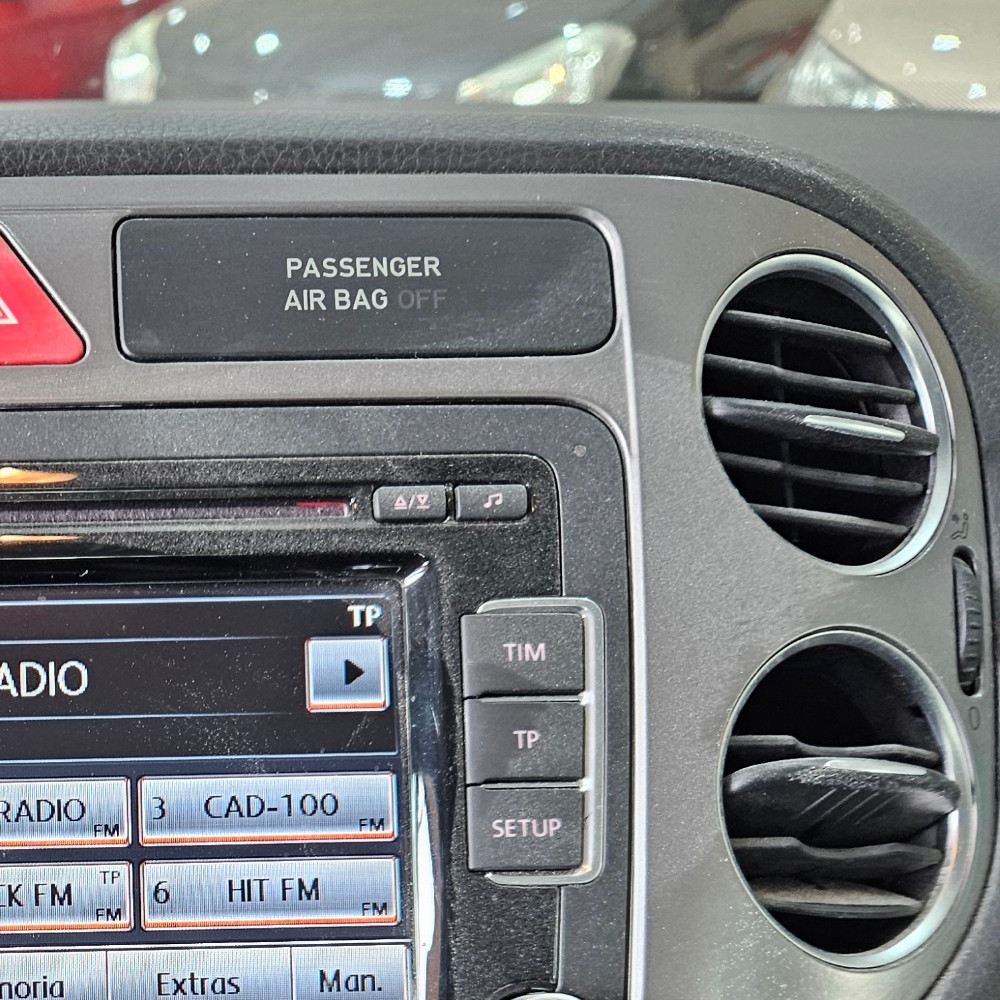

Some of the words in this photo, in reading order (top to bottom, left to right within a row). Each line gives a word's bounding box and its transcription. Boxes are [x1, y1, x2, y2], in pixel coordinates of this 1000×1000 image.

[286, 256, 441, 278] PASSENGER
[284, 289, 327, 311] AIR
[334, 288, 388, 310] BAG
[397, 288, 448, 310] OFF
[347, 604, 382, 627] TP
[503, 642, 546, 662] TIM
[512, 730, 540, 750] TP
[152, 796, 166, 821] 3
[203, 792, 339, 819] CAD-100
[93, 823, 120, 838] FM
[358, 817, 385, 832] FM
[491, 818, 562, 839] SETUP
[99, 870, 121, 885] TP
[34, 882, 73, 907] FM
[153, 880, 170, 904] 6
[227, 878, 269, 903] HIT
[281, 876, 320, 901] FM
[95, 908, 122, 922] FM
[361, 902, 388, 916] FM
[157, 971, 241, 997] Extras
[319, 969, 383, 993] Man.
